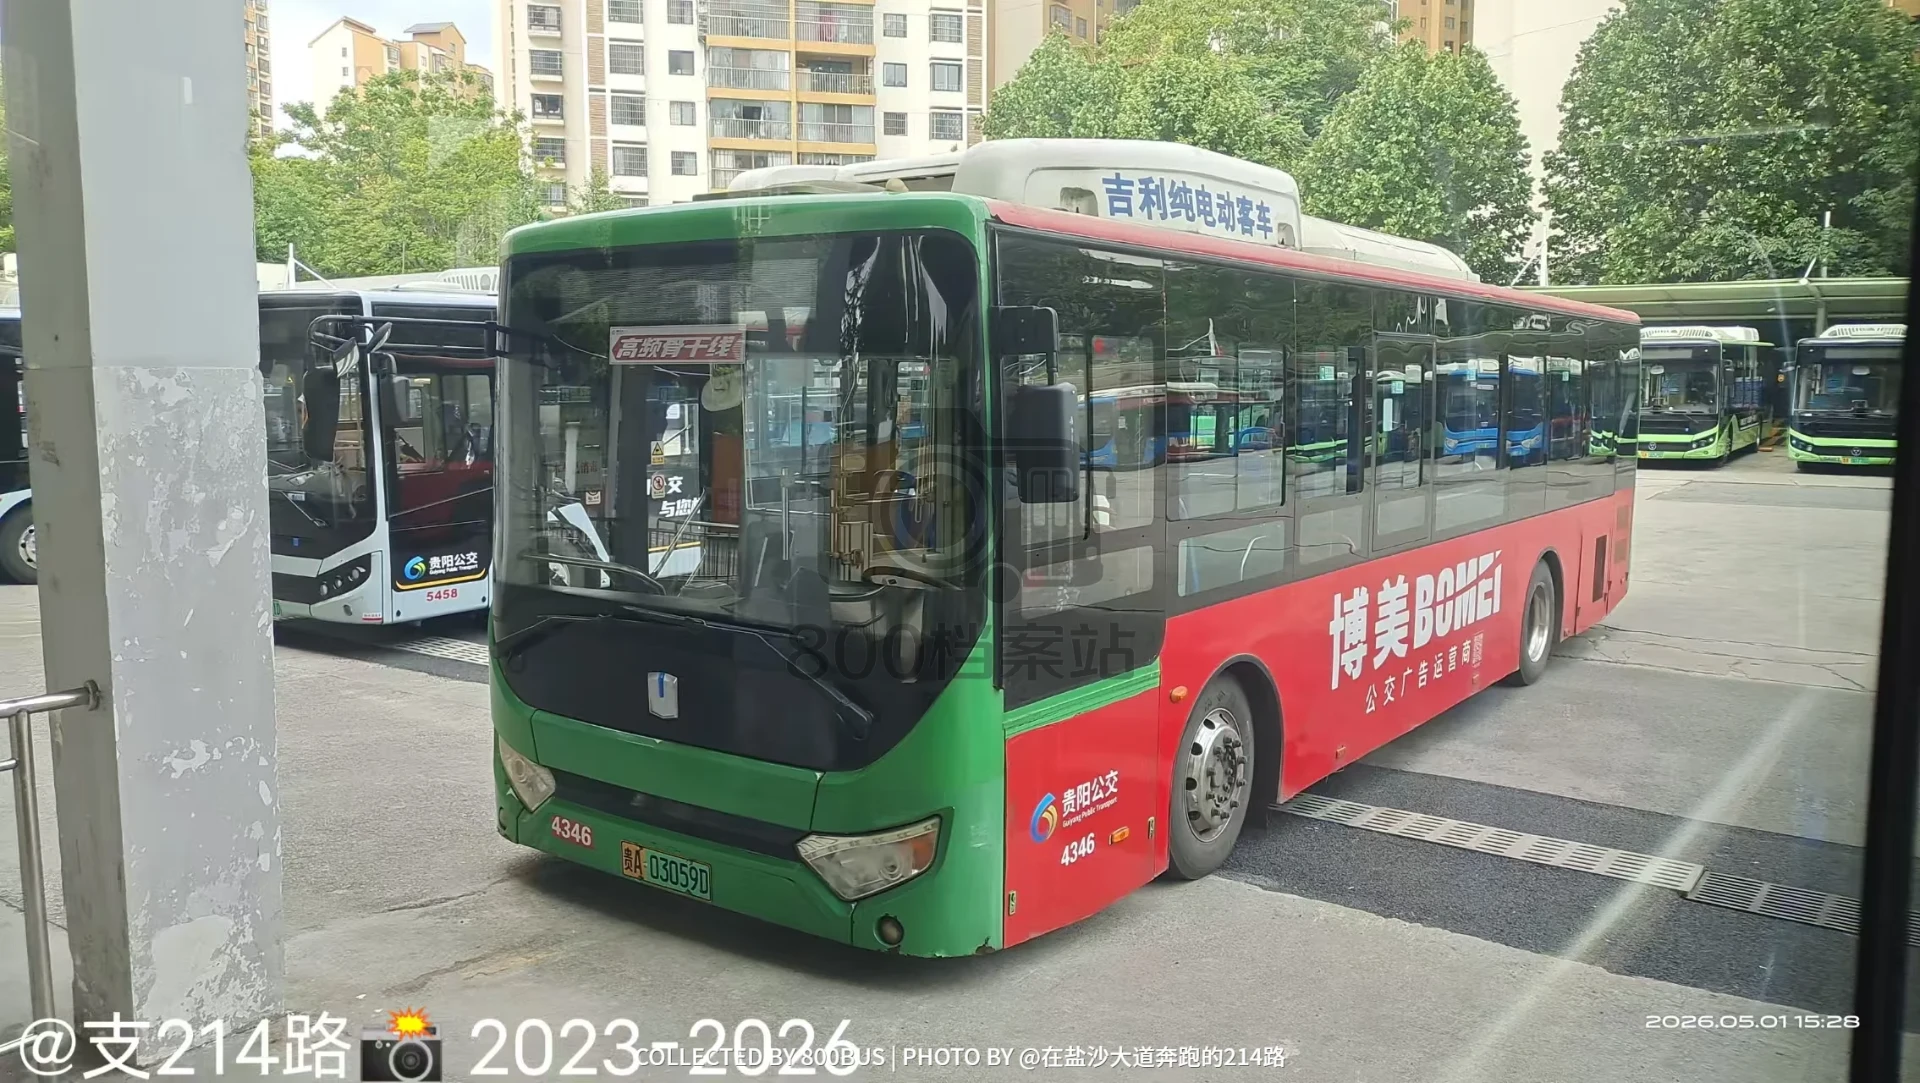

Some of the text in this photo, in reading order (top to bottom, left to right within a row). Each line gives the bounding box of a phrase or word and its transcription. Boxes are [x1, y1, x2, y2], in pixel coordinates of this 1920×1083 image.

[1102, 172, 1273, 239] 吉利纯电动客车
[616, 336, 735, 358] 高频骨干线
[429, 552, 478, 570] 贵阳公交
[426, 588, 458, 602] 5458
[1365, 640, 1471, 714] 公交广告运营商
[1062, 770, 1118, 818] 贵阳公交
[1063, 797, 1118, 828] Guiyang Public Transport
[551, 816, 592, 846] 4346
[1060, 832, 1095, 866] 4346
